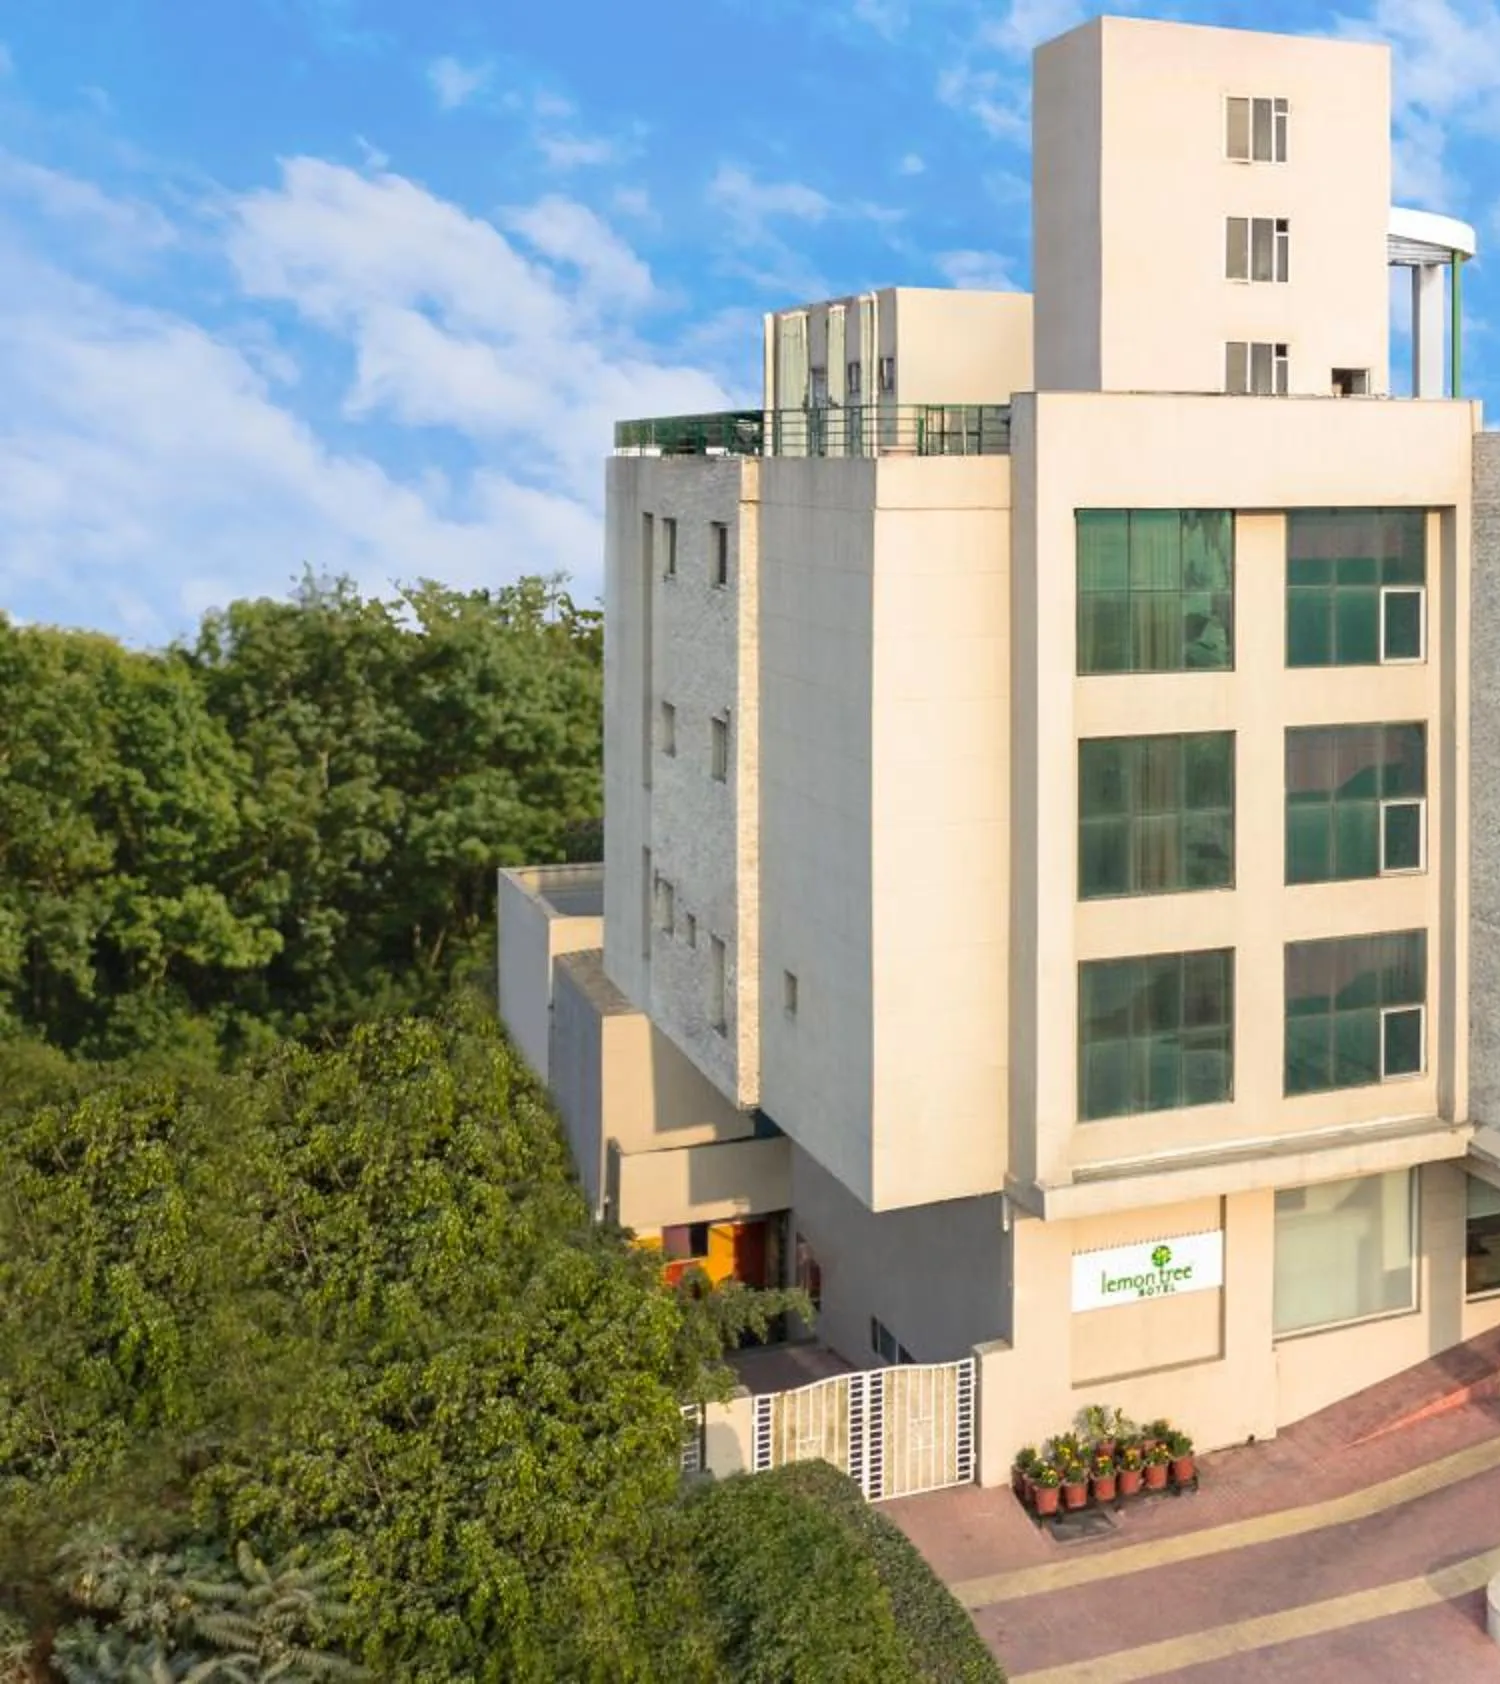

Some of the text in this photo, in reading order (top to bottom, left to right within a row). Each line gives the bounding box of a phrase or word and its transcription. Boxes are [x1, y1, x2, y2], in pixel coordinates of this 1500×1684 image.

[1101, 1266, 1193, 1295] lemon tree
[1138, 1284, 1176, 1298] HOTEL
